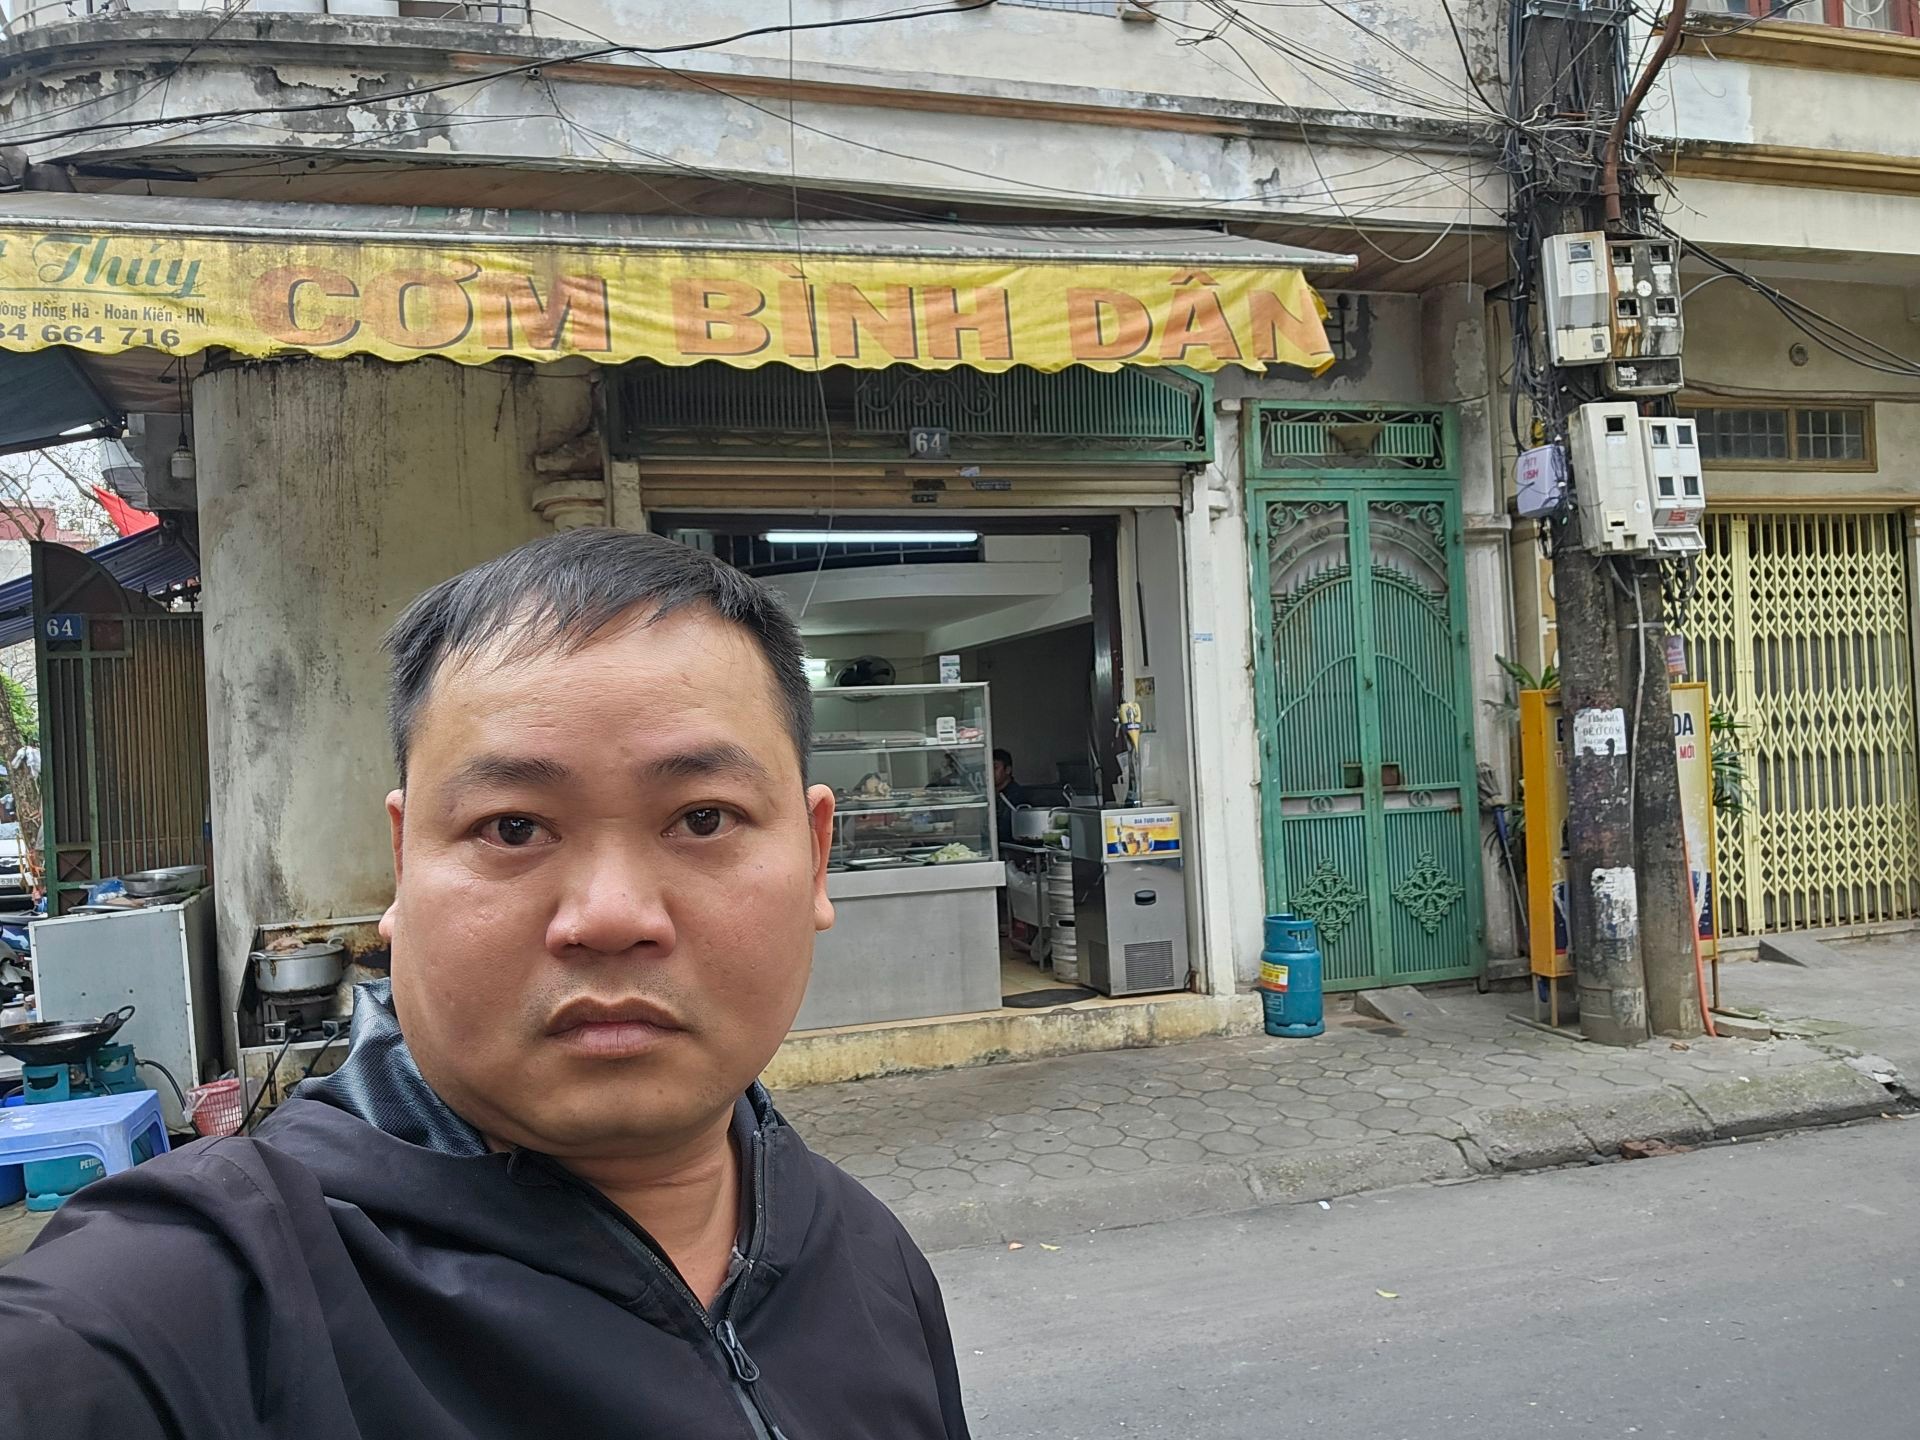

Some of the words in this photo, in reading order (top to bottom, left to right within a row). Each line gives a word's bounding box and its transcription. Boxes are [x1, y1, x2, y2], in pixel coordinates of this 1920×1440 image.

[32, 299, 67, 320] Hồng
[72, 302, 89, 318] Hà
[104, 303, 138, 320] Hoàn
[186, 307, 205, 323] HN
[250, 258, 612, 352] CƠM
[670, 260, 1014, 361] BÌNH
[1066, 268, 1335, 361] DÂN
[41, 324, 105, 344] 664
[118, 327, 181, 347] 716
[915, 432, 942, 453] 64
[46, 618, 73, 637] 64
